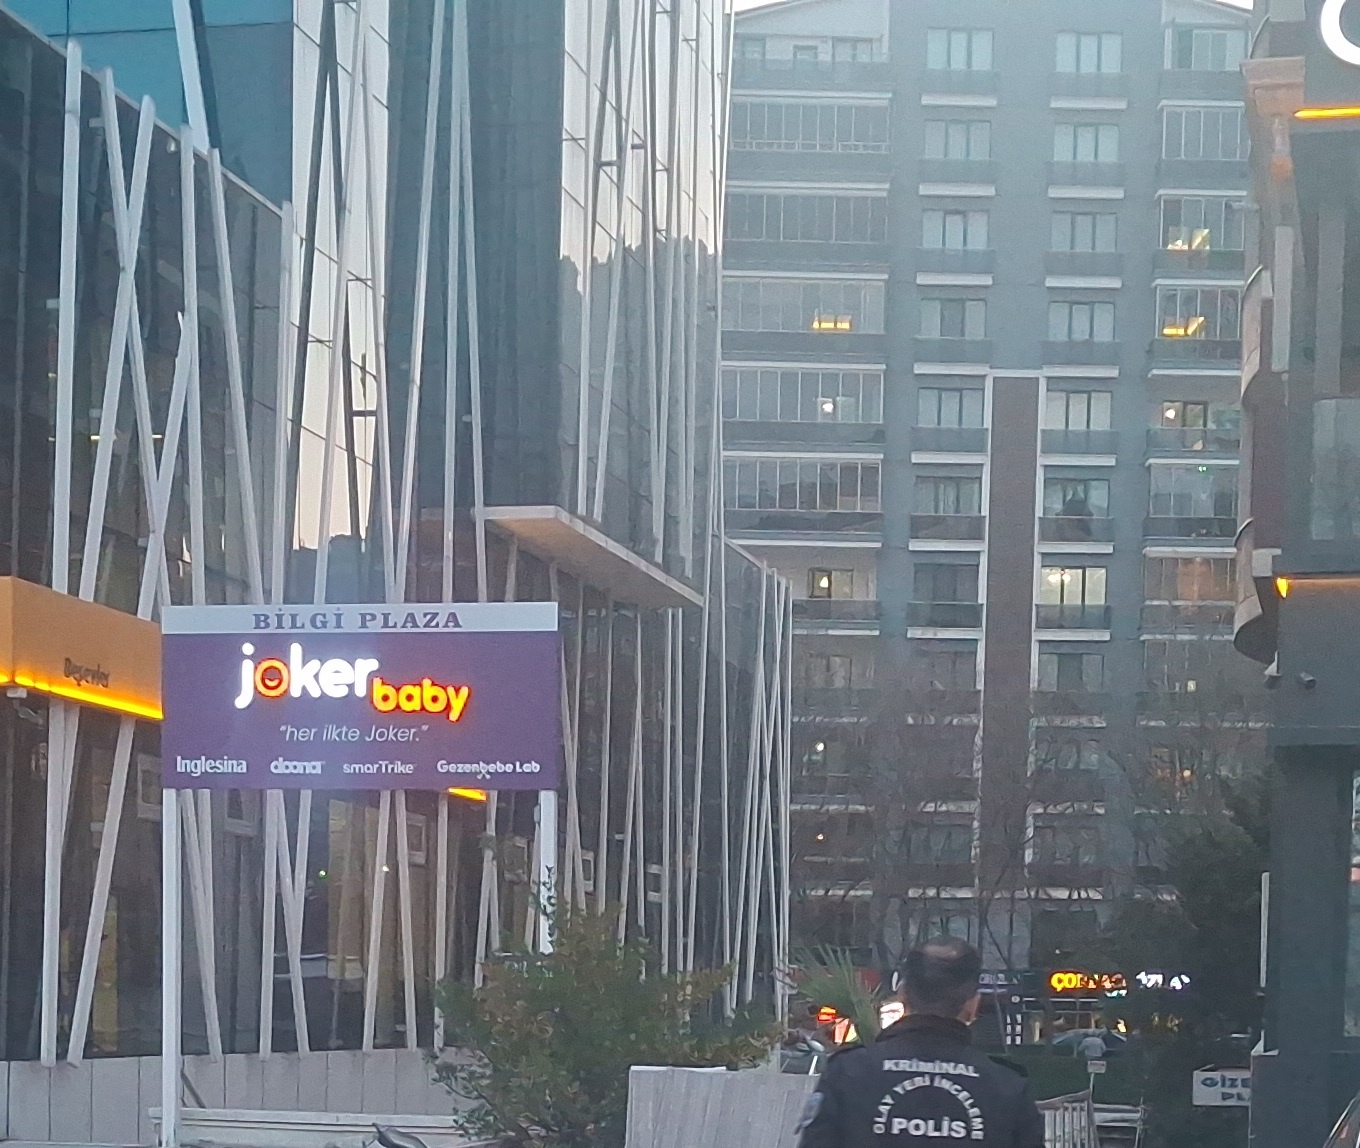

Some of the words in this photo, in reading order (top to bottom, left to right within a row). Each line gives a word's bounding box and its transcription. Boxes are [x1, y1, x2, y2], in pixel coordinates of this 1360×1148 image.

[253, 607, 344, 630] BİLGİ
[358, 611, 463, 629] PLAZA
[234, 642, 379, 709] joker
[371, 677, 471, 722] baby
[323, 724, 360, 742] ilkte
[177, 756, 247, 775] Inglesina
[343, 761, 415, 774] smarTrike
[515, 761, 540, 773] Lab
[882, 1058, 979, 1077] KRİMİNAL
[873, 1094, 894, 1134] OLAY
[891, 1116, 967, 1138] POLİS
